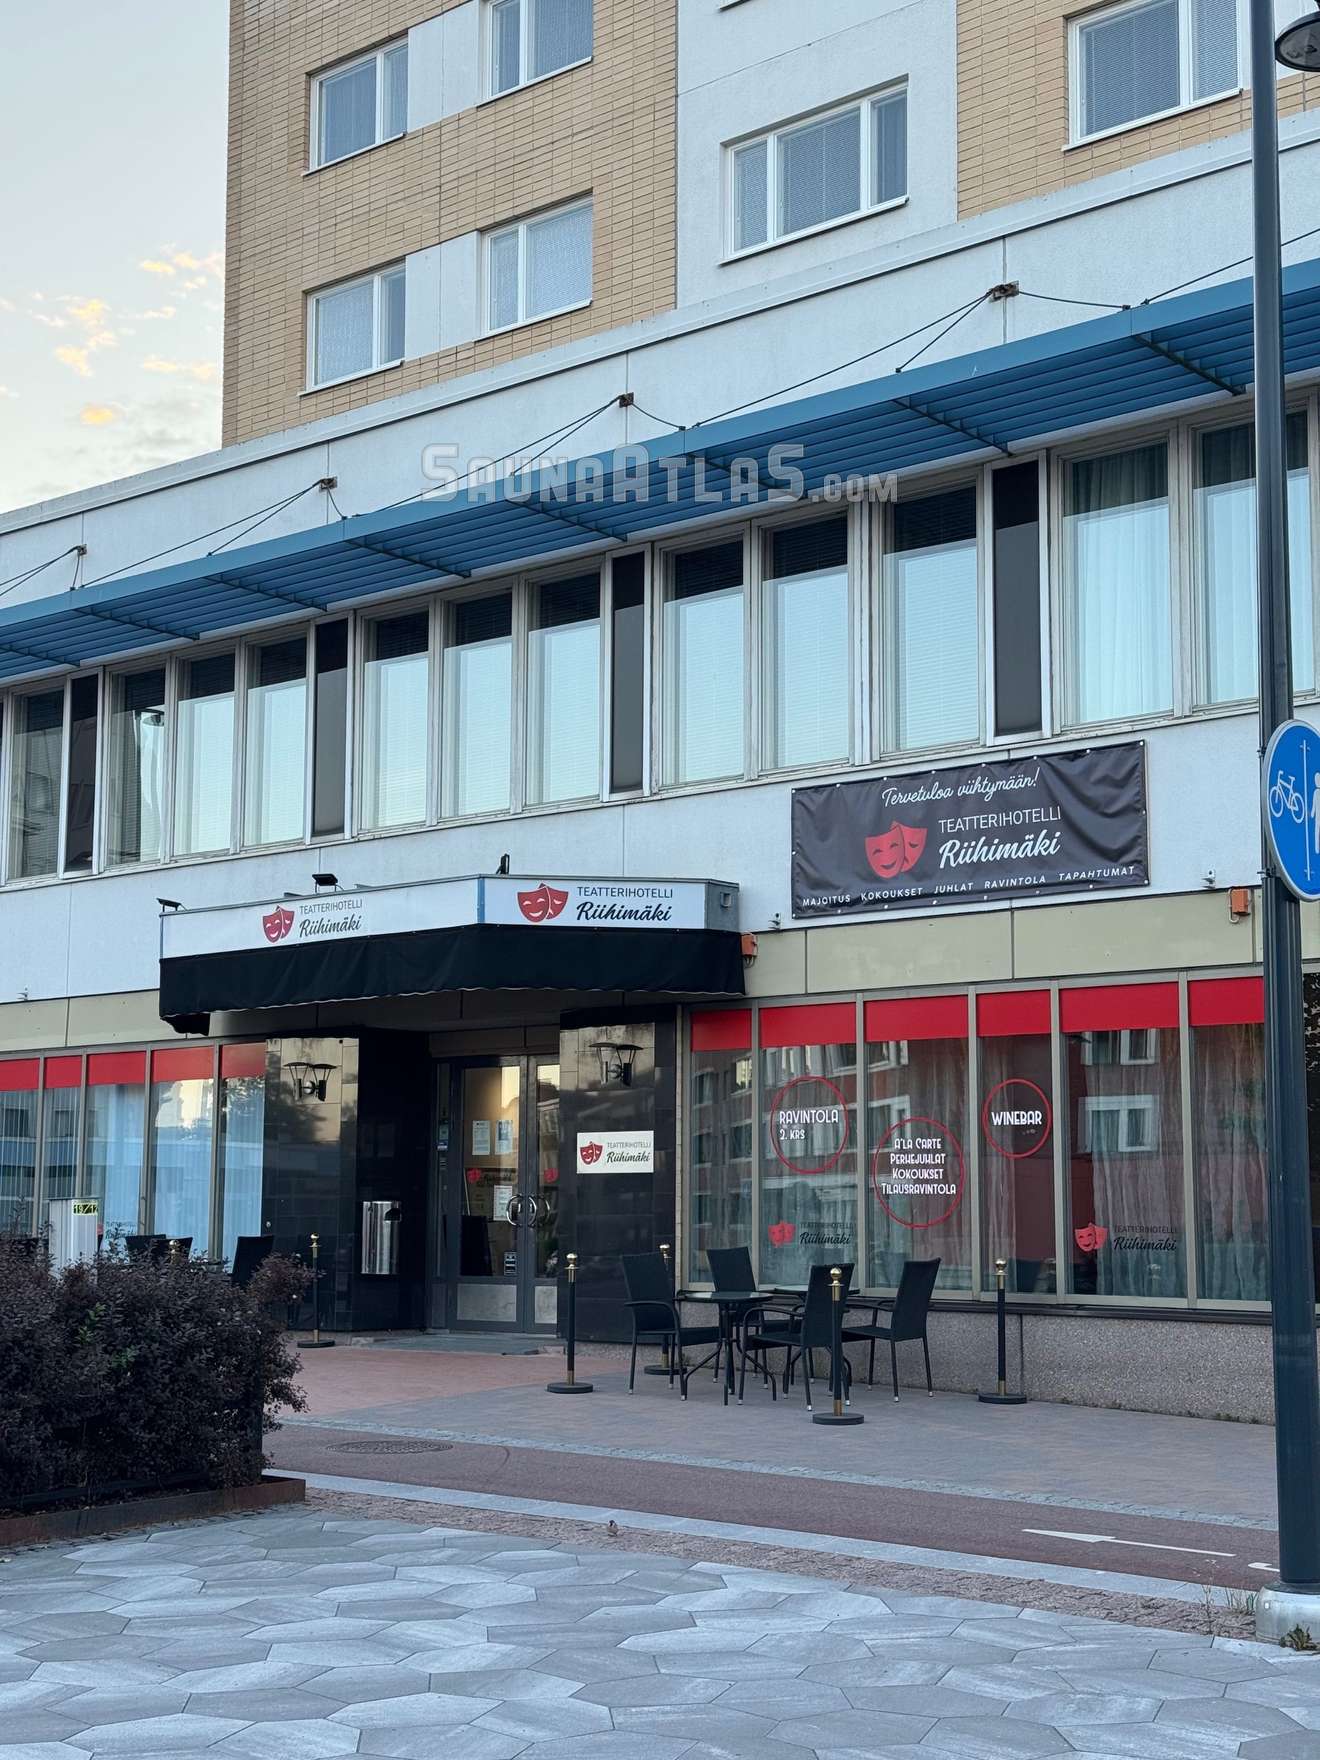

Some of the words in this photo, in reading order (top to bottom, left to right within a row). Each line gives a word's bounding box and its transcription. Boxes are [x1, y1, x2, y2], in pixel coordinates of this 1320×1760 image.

[882, 782, 954, 807] Tervetuloa
[957, 767, 1040, 801] viihtymään!
[938, 806, 1061, 833] TEATTERIHOTELLI
[939, 829, 1061, 869] Riihimäki
[577, 886, 673, 898] TEATTERIHOTELLI
[803, 894, 851, 906] MAJOITUS
[861, 887, 924, 901] KOKOUKSET
[934, 882, 974, 894] JUHLAT
[984, 875, 1046, 889] RAVINTOLA
[1059, 866, 1134, 881] TAPAHTUMAT
[300, 899, 363, 915] TEATTERIHOTELLI
[576, 901, 672, 921] Riihimäki
[299, 914, 361, 938] Riihimäki
[779, 1109, 839, 1124] RAVINTOLA
[991, 1110, 1042, 1126] WINEBAR
[779, 1129, 788, 1140] 2.
[790, 1129, 806, 1140] KRS
[606, 1150, 651, 1163] Riihimäki
[1113, 1236, 1177, 1251] Riihimäki
